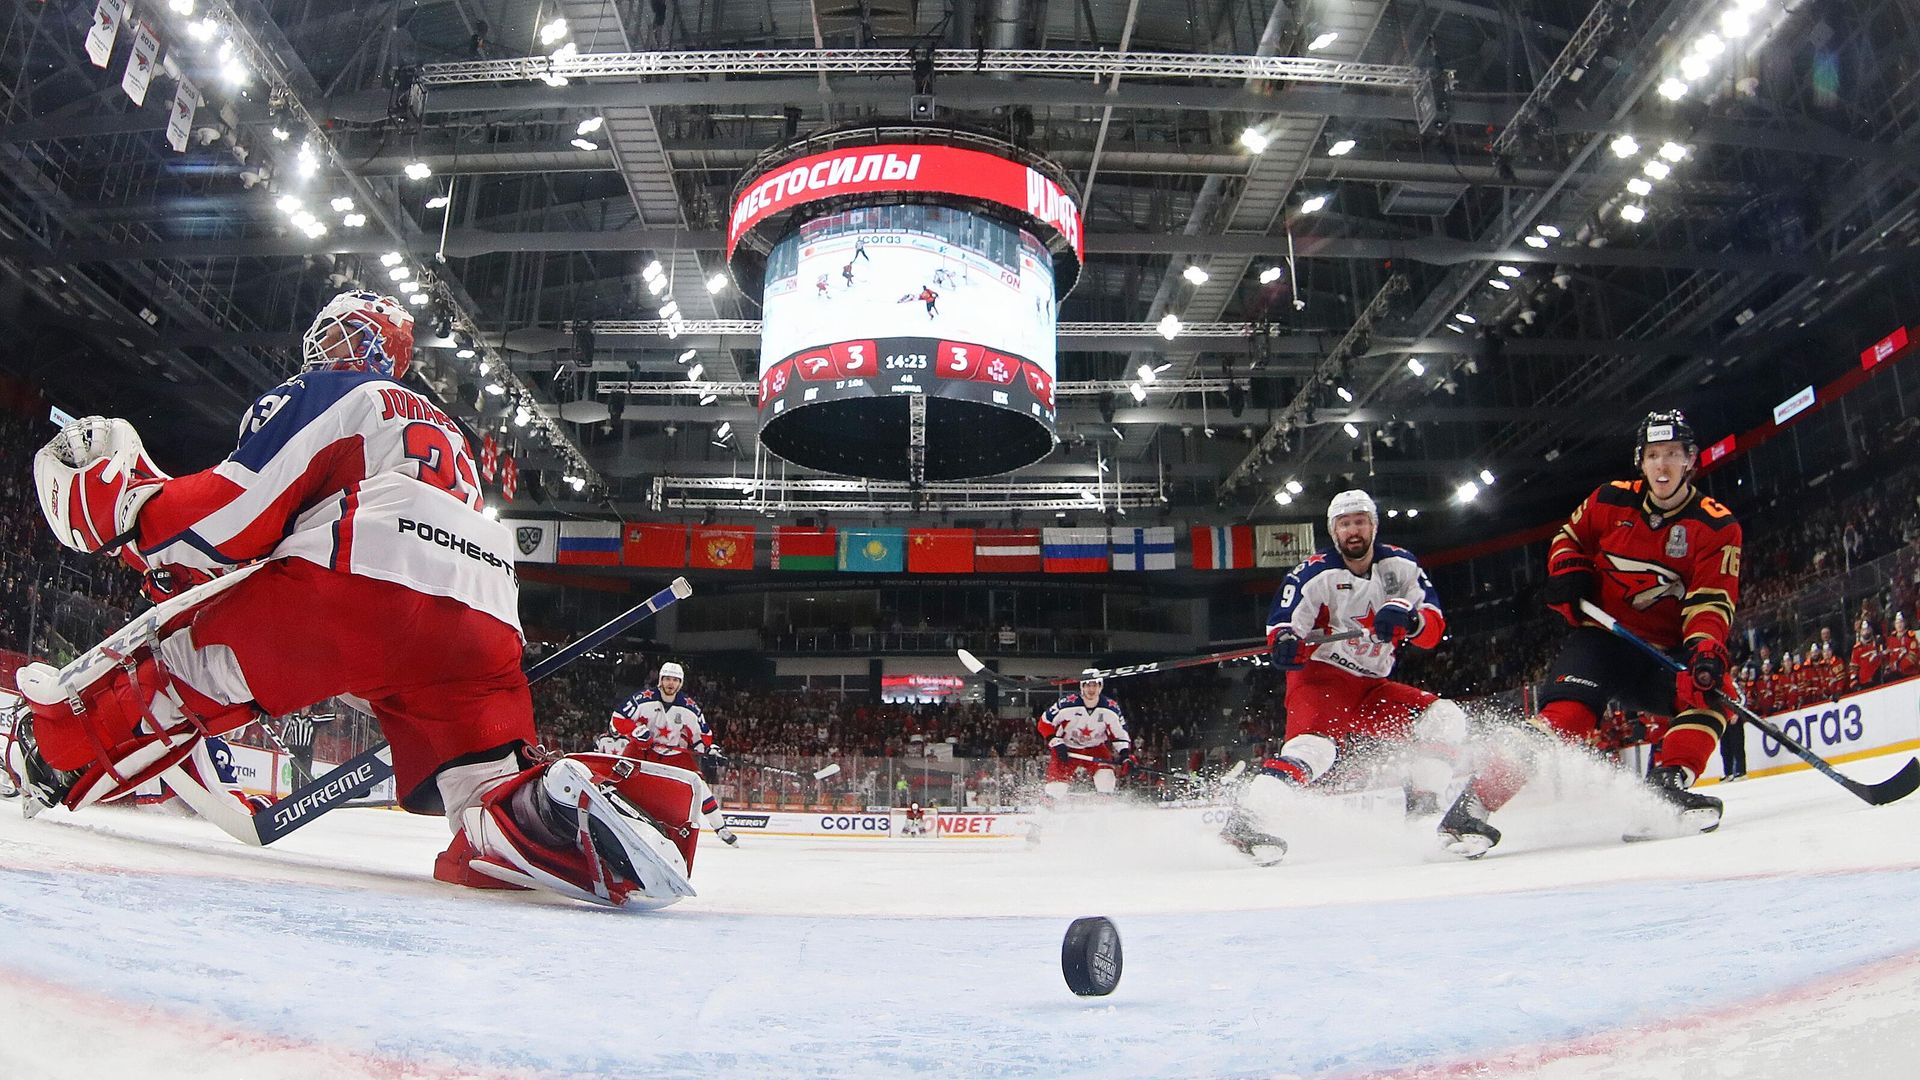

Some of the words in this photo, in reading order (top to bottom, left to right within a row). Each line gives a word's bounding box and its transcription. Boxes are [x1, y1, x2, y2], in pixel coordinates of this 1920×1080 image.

[846, 346, 864, 370] 3
[885, 354, 927, 370] 14:23
[950, 347, 968, 372] 3
[1280, 584, 1296, 608] 9
[274, 762, 374, 831] SUPREME
[820, 816, 891, 831] согаз
[924, 817, 997, 833] ONBET
